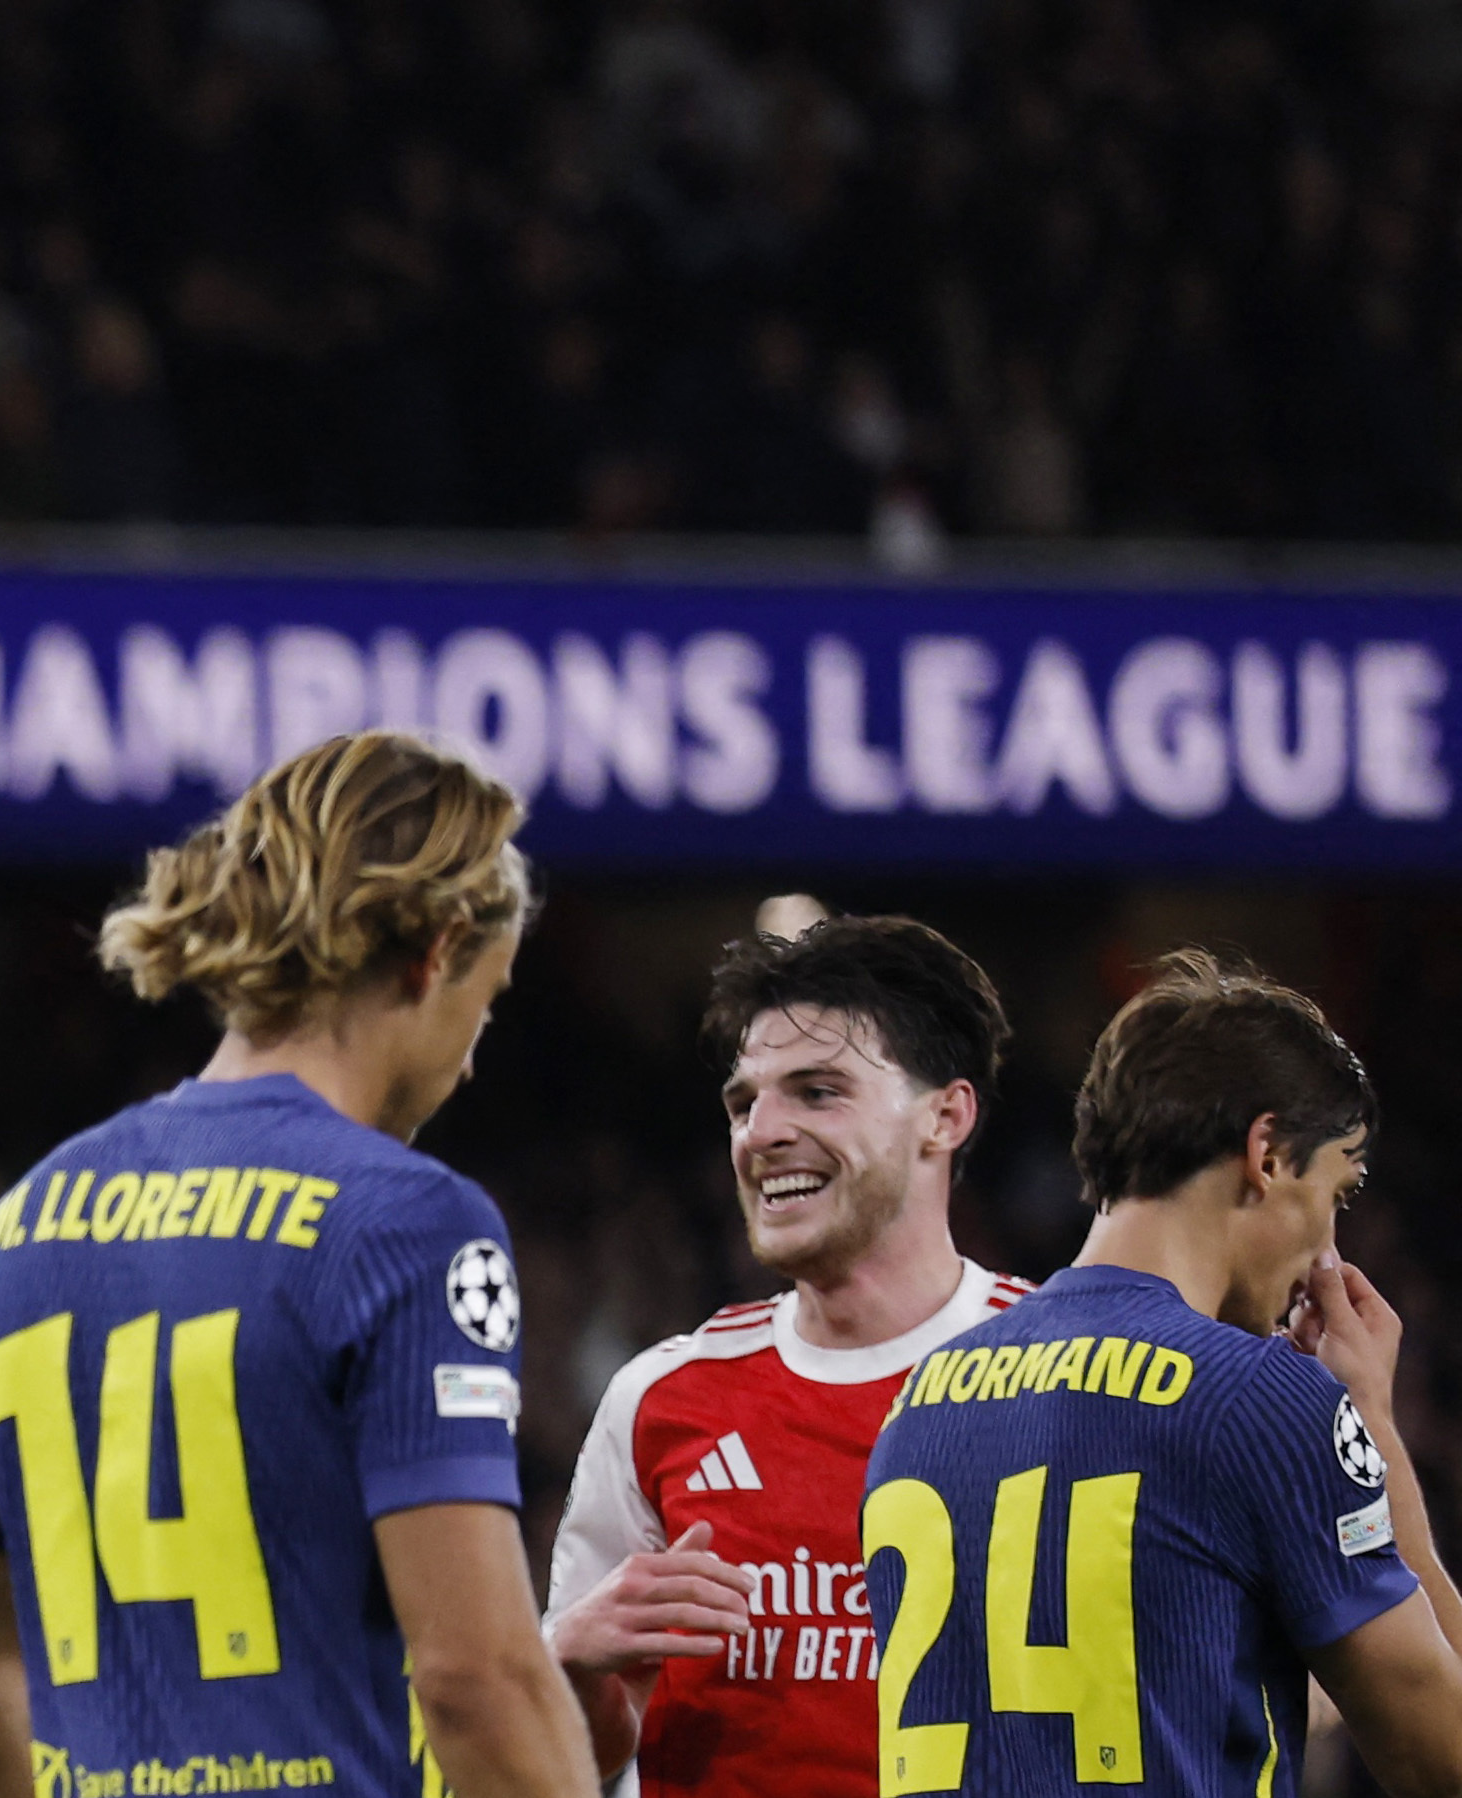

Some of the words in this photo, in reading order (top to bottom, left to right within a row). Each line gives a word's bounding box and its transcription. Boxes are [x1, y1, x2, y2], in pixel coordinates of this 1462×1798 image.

[805, 638, 1454, 822] LEAGUE
[33, 1168, 338, 1249] LLORENTE
[911, 1337, 1194, 1406] NORMAND
[862, 1465, 1144, 1798] 24
[132, 1757, 193, 1796] the
